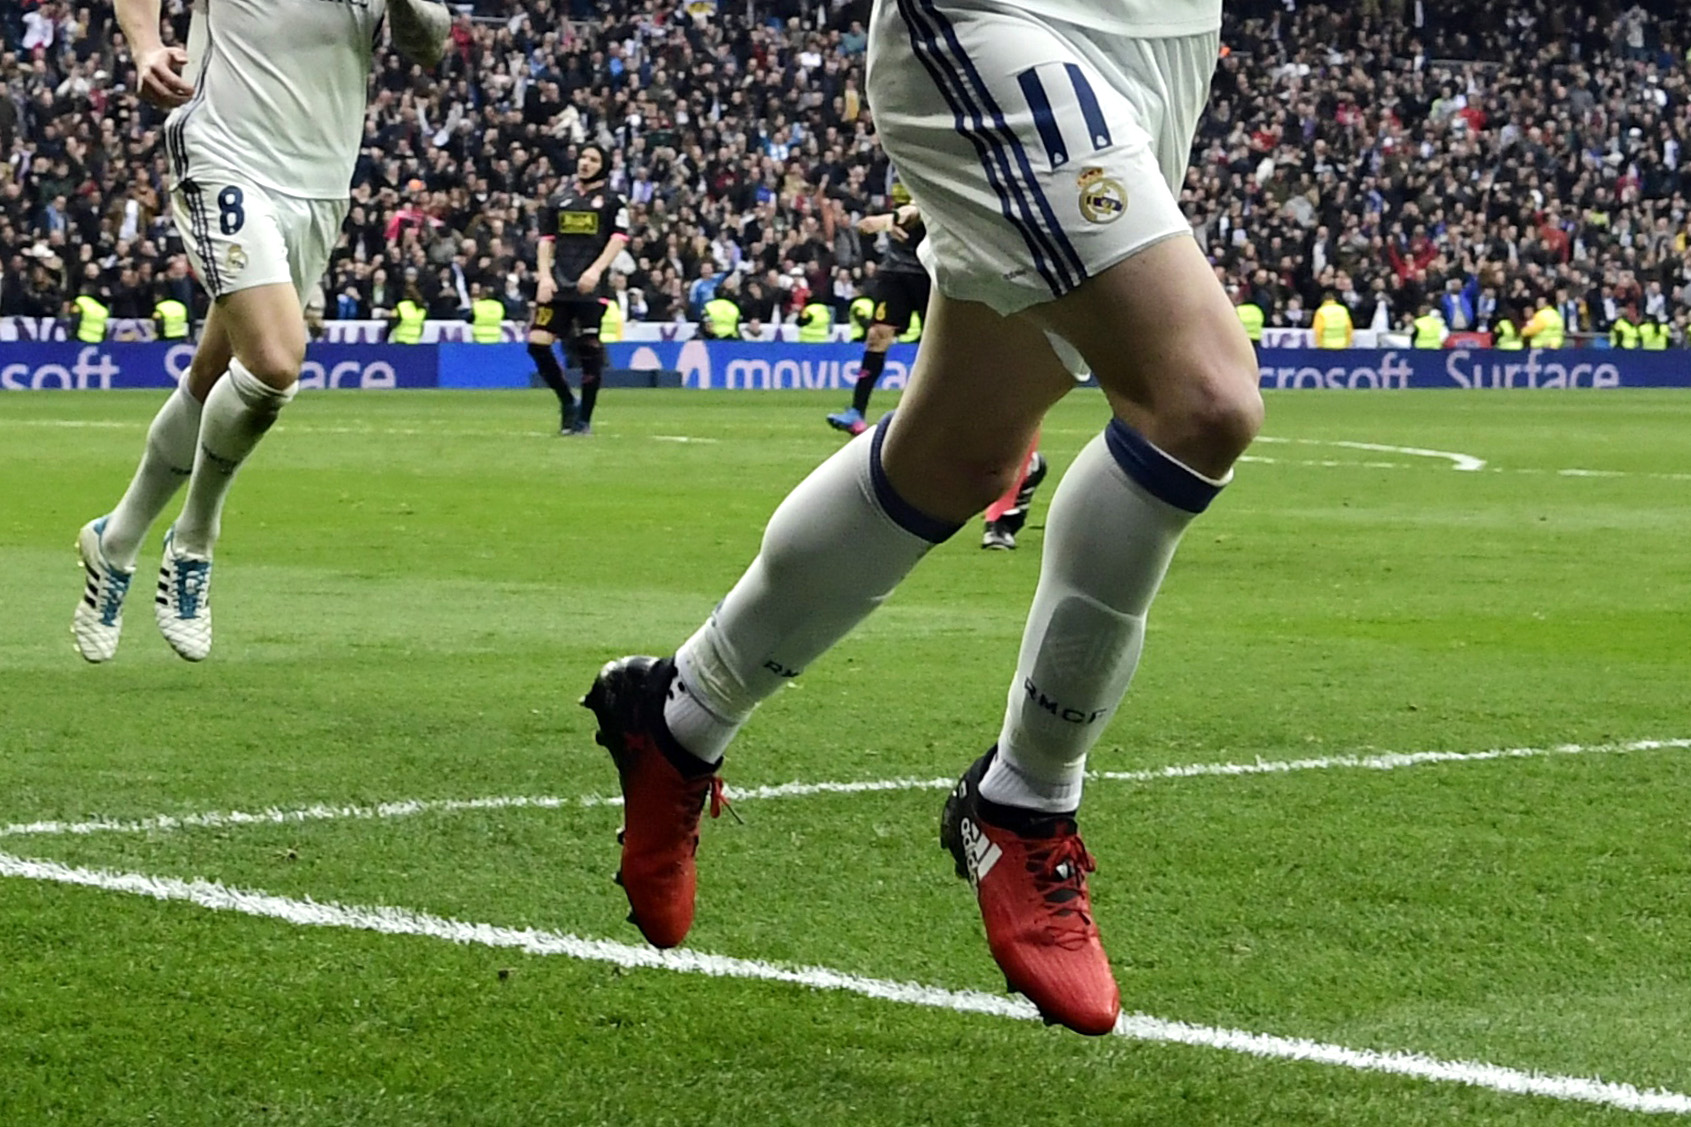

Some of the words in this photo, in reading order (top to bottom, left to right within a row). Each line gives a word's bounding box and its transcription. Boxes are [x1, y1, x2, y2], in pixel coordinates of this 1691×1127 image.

[1017, 62, 1113, 169] 11
[217, 184, 246, 237] 8
[875, 301, 887, 321] 6
[1446, 348, 1620, 389] Surface
